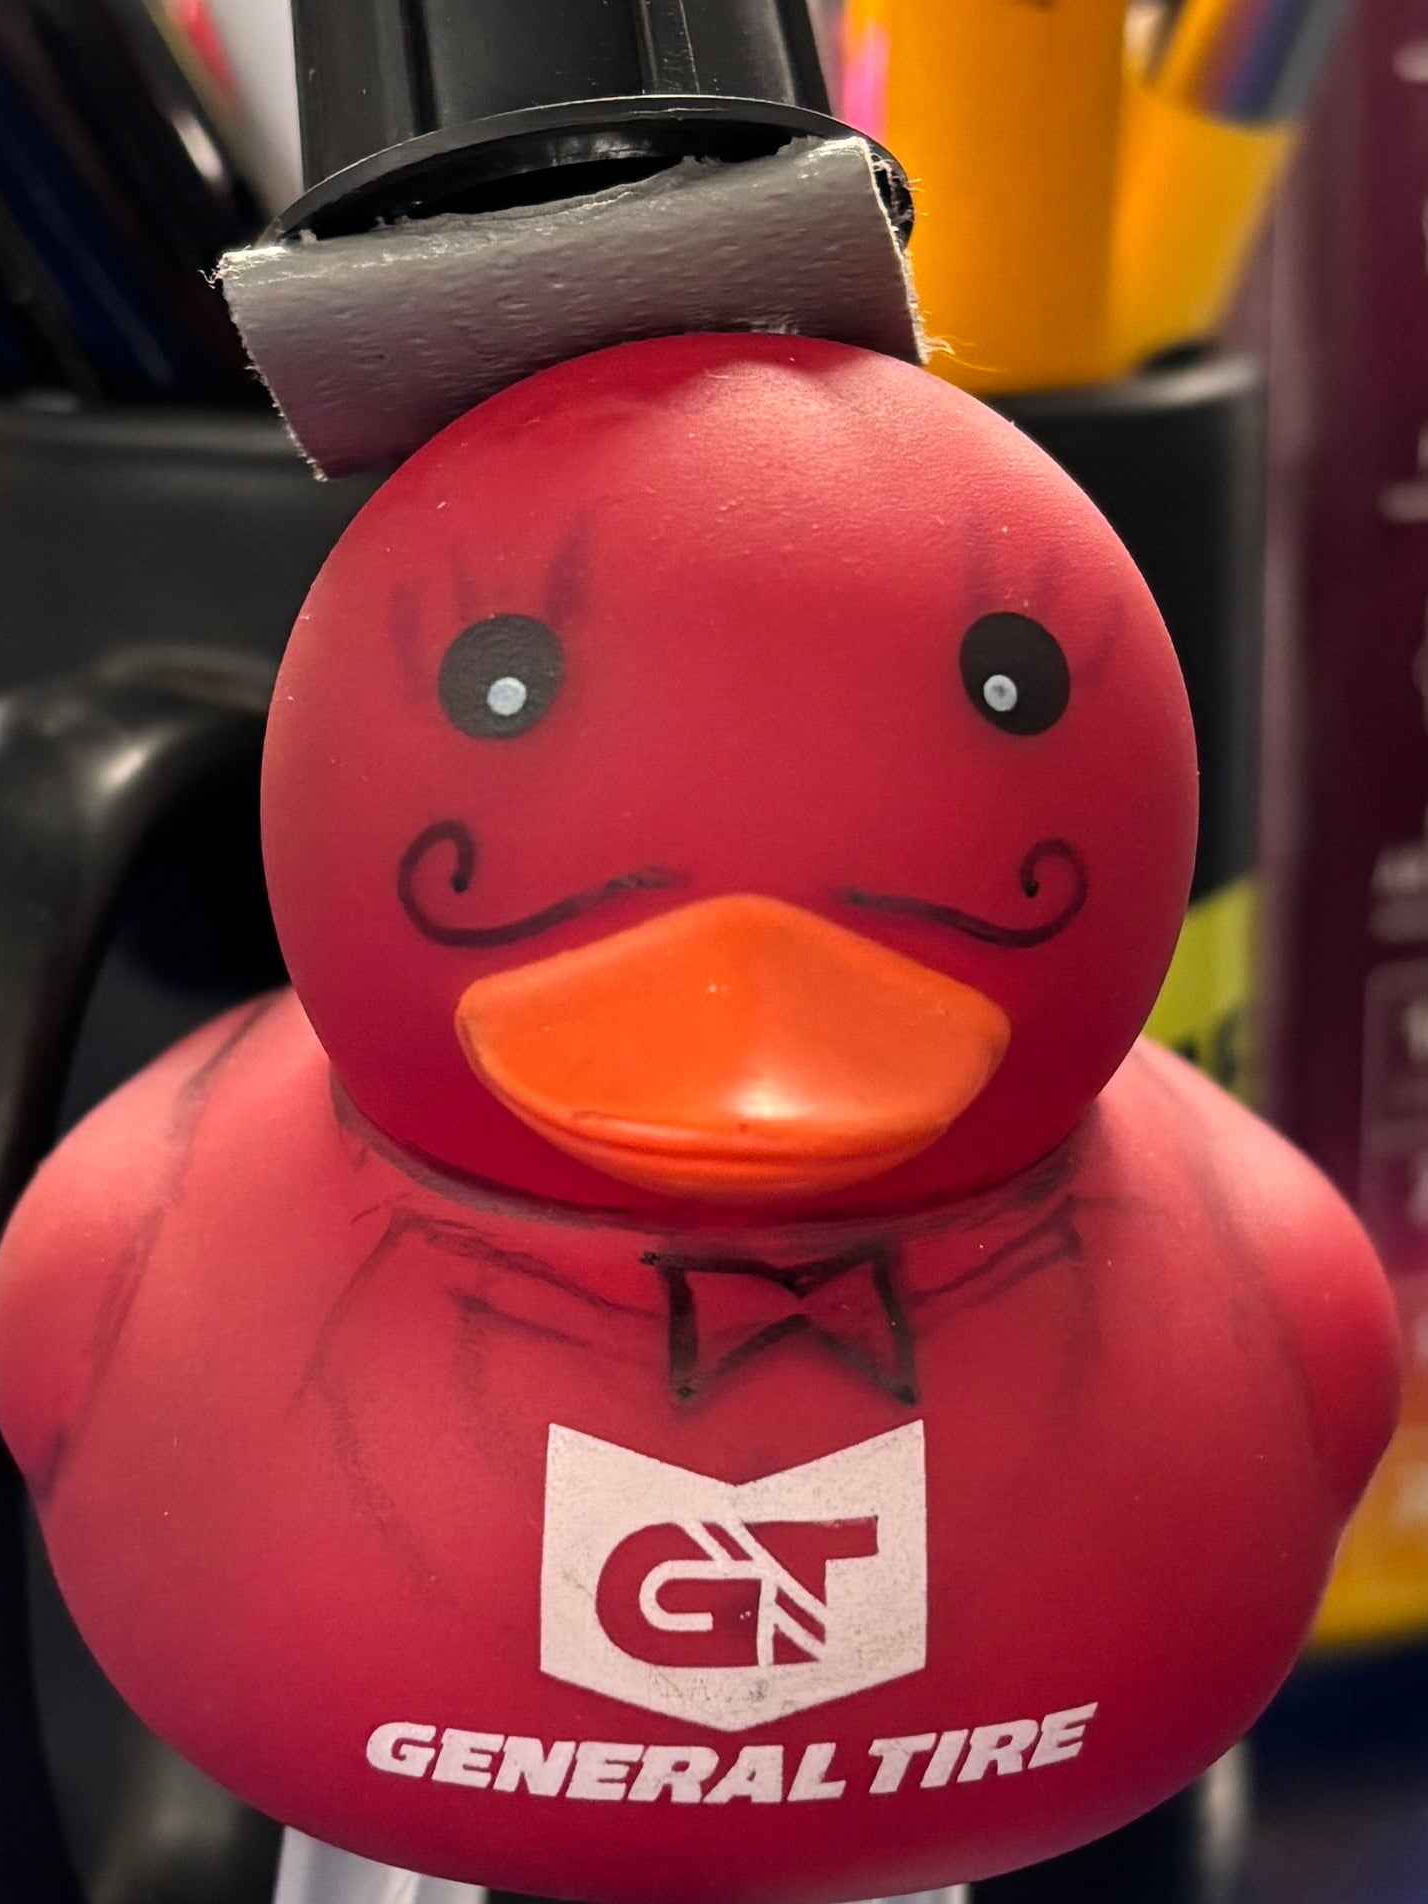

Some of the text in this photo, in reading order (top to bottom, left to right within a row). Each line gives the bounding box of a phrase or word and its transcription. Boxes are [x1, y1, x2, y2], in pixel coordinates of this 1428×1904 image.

[595, 1515, 879, 1668] GT
[366, 1701, 1099, 1805] GENERAL TIRE
